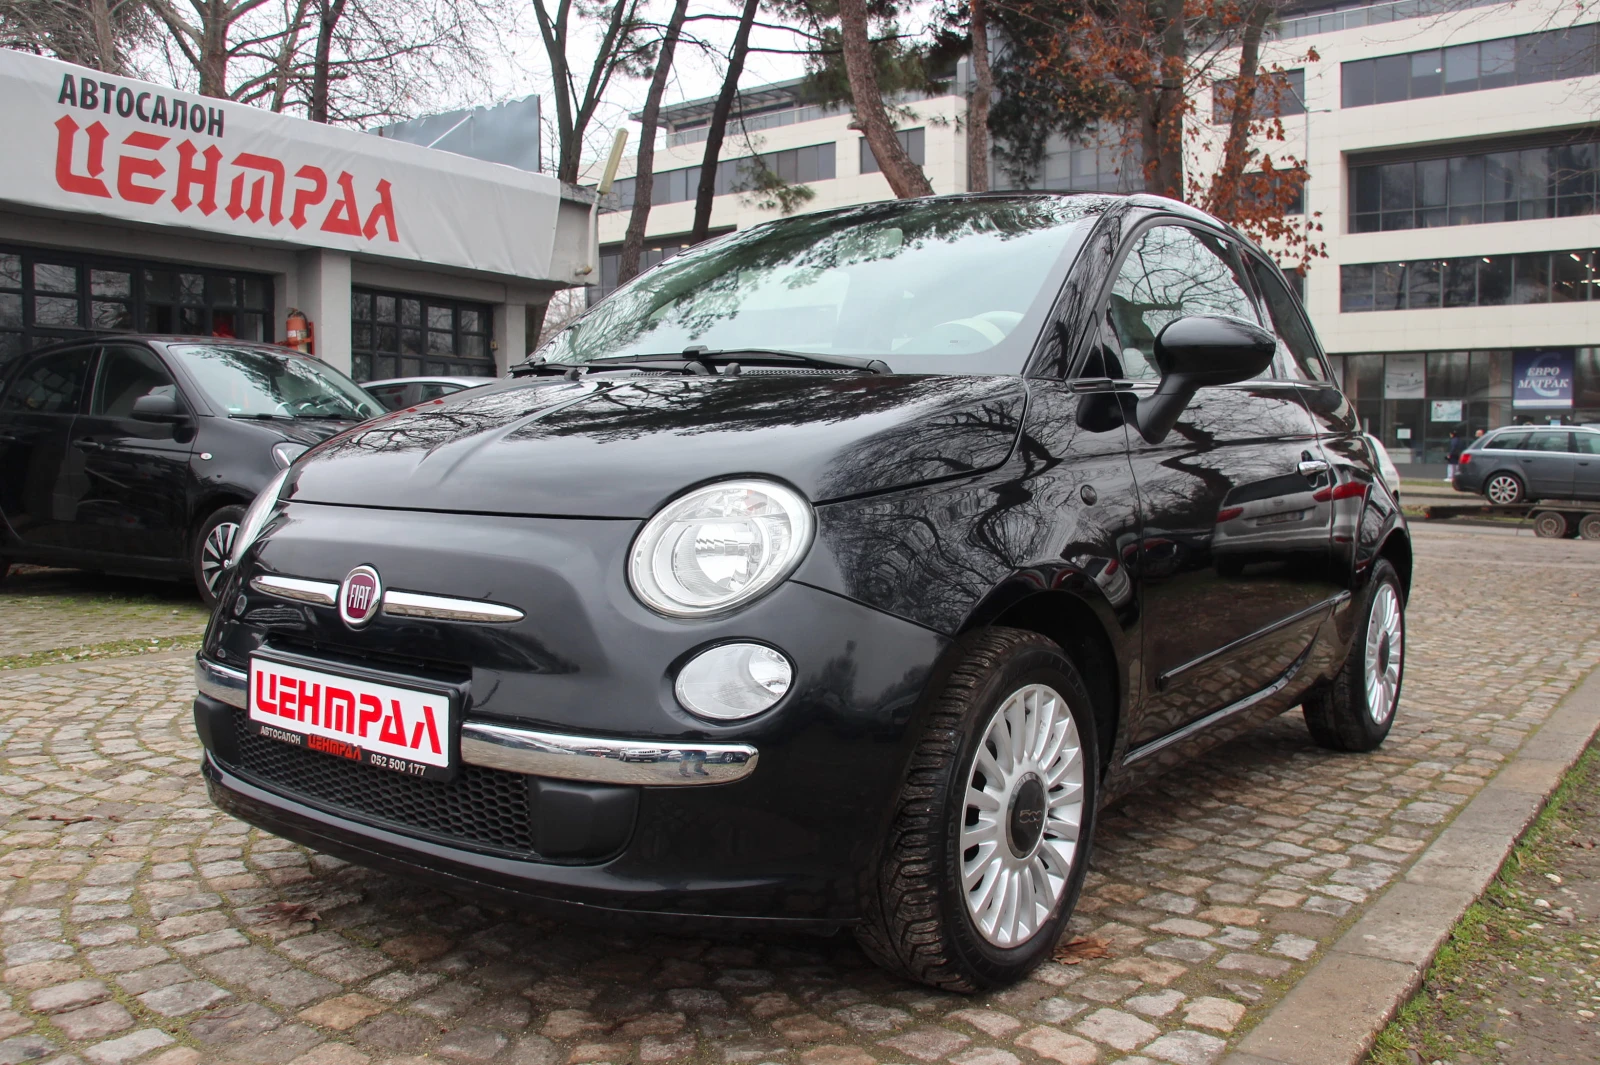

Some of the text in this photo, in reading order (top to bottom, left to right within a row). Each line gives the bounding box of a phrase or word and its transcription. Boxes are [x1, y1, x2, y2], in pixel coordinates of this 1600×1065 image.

[58, 73, 225, 138] АВТОСАЛОН
[54, 114, 400, 243] ЦЕНТРАЛ
[1518, 378, 1569, 389] МАТРАК
[1527, 367, 1560, 376] ЕВРО
[348, 584, 371, 610] FIAT
[256, 670, 443, 755] ЦЕНТРАЛ
[260, 725, 426, 776] АВТОСАЛОН ЦЕНТРАЛ 052 500 177
[946, 786, 957, 891] UNIROY
